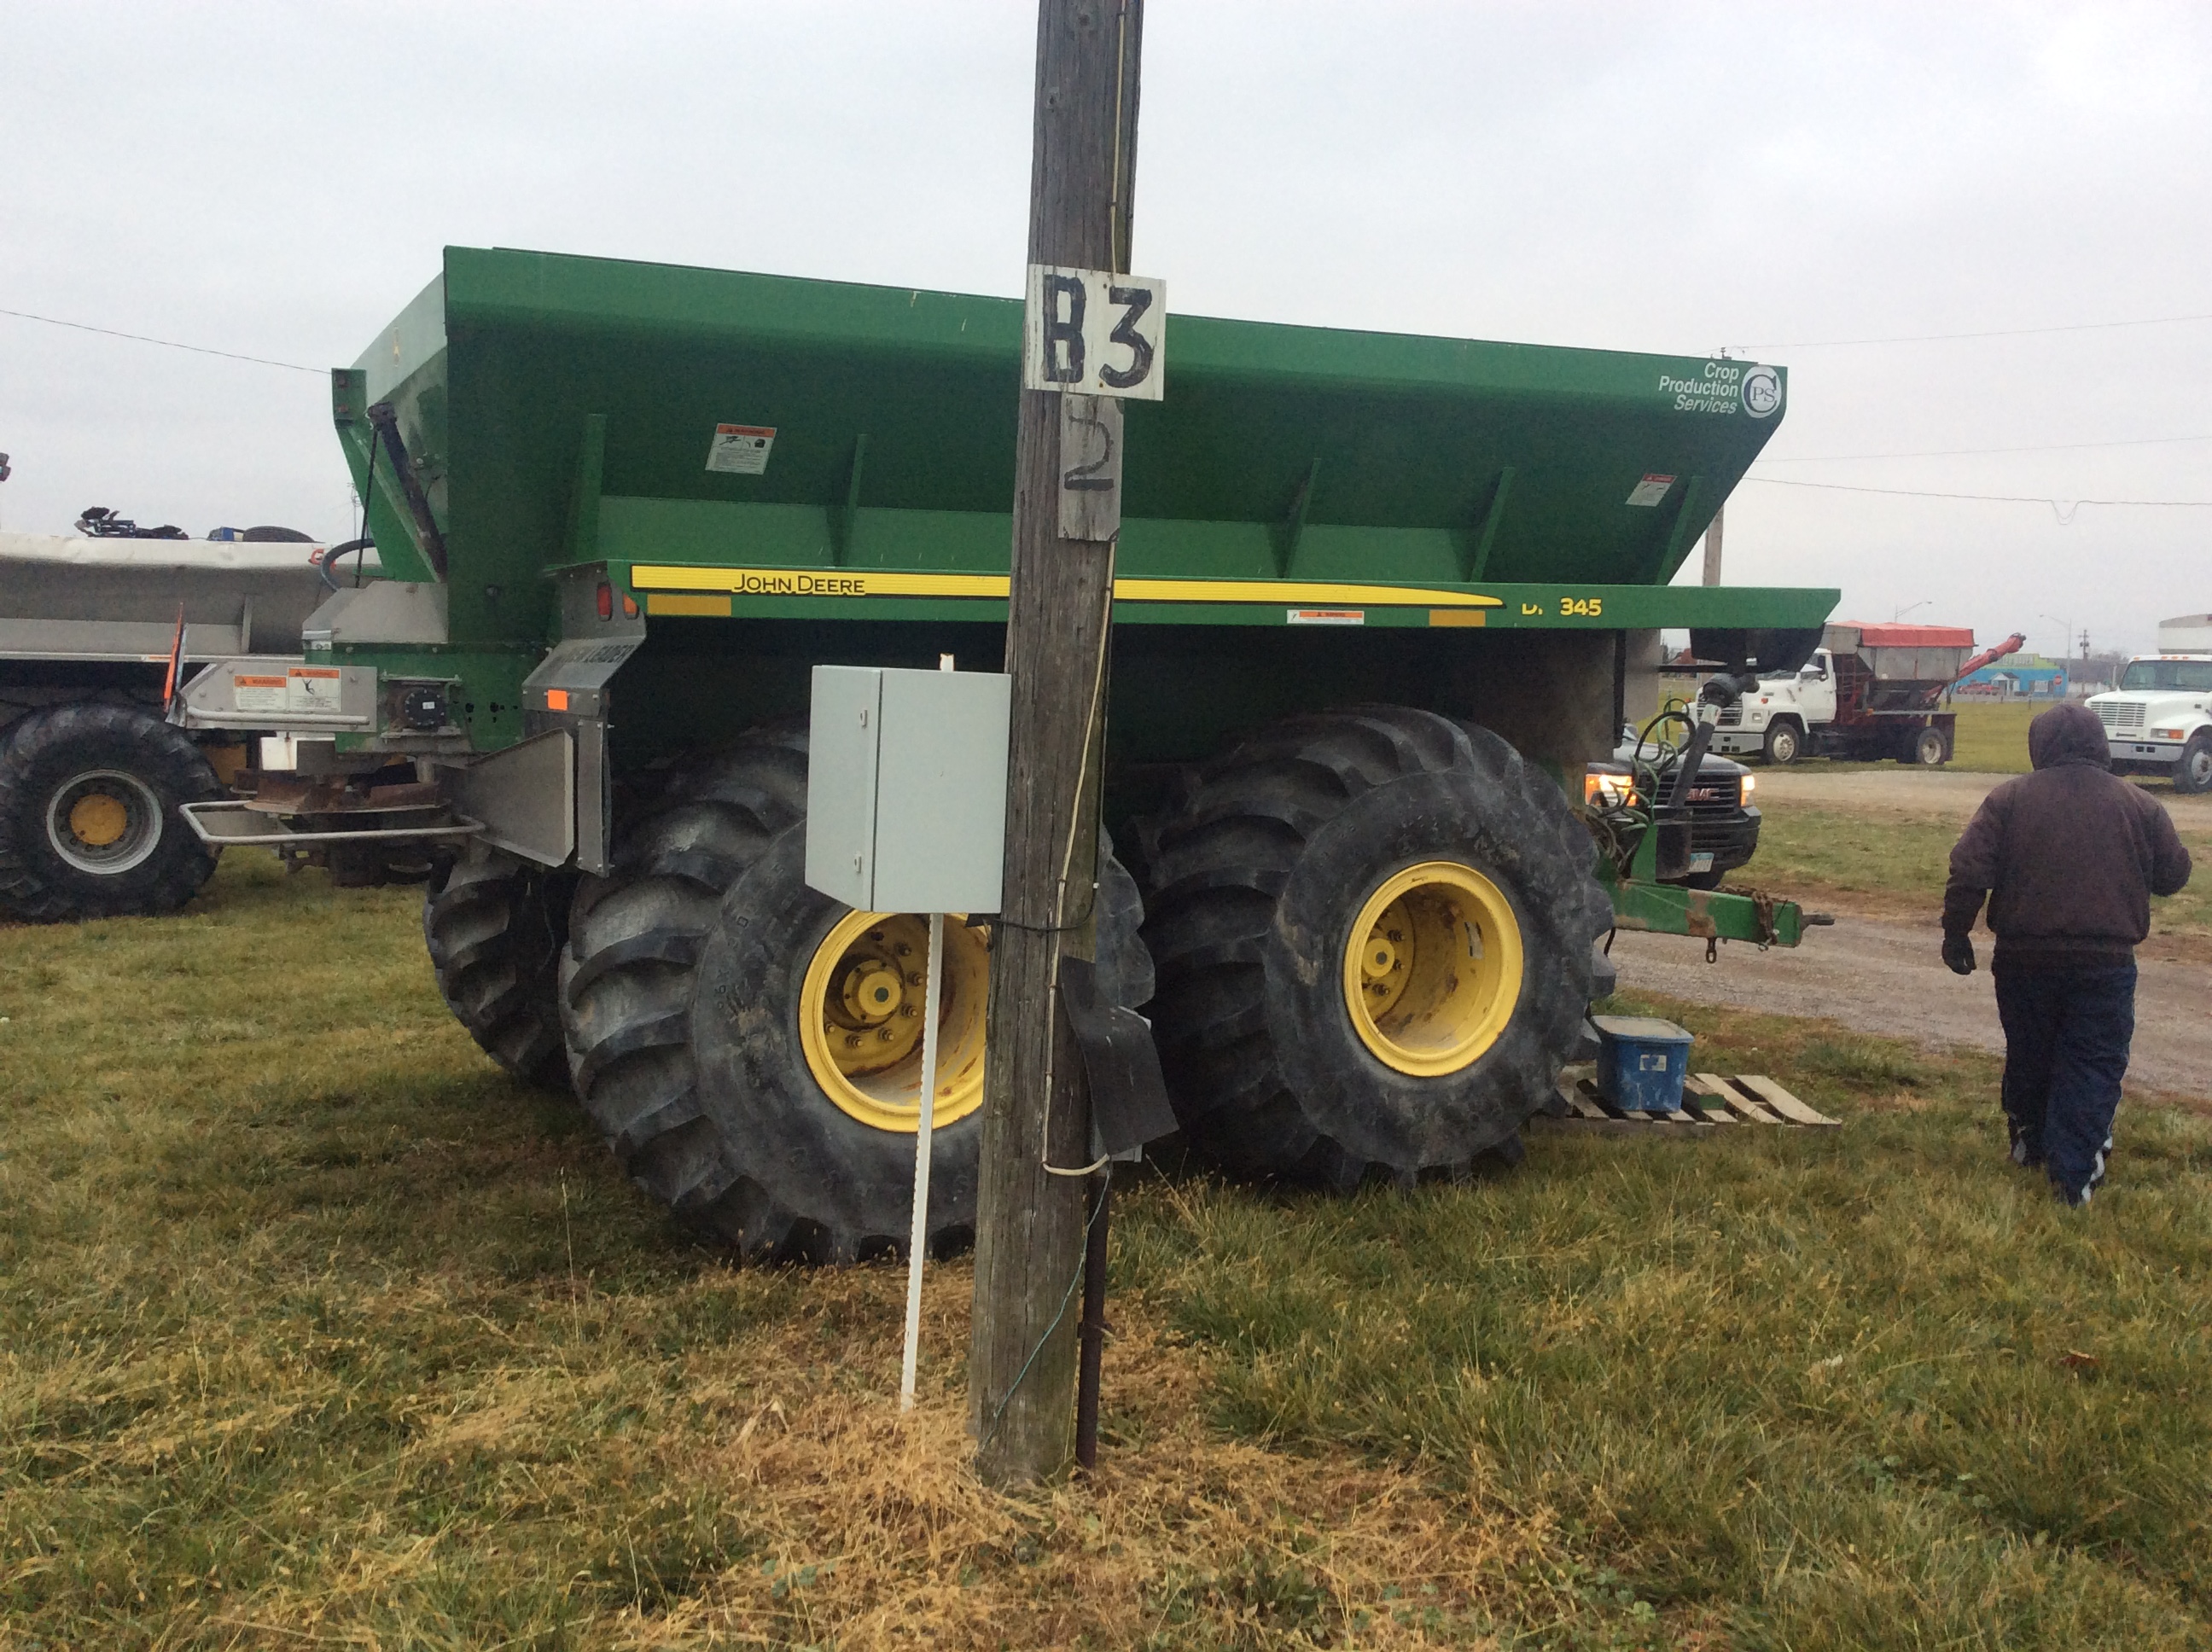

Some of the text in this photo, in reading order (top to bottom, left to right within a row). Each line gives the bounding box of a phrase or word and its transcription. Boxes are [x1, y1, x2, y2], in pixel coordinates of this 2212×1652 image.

[1042, 273, 1153, 388] B3
[1703, 362, 1740, 383] Crop
[1658, 375, 1738, 398] Production
[1674, 394, 1738, 415] Services
[1063, 415, 1115, 491] 2
[734, 573, 865, 593] JOHN DEERE
[1560, 597, 1603, 616] 345
